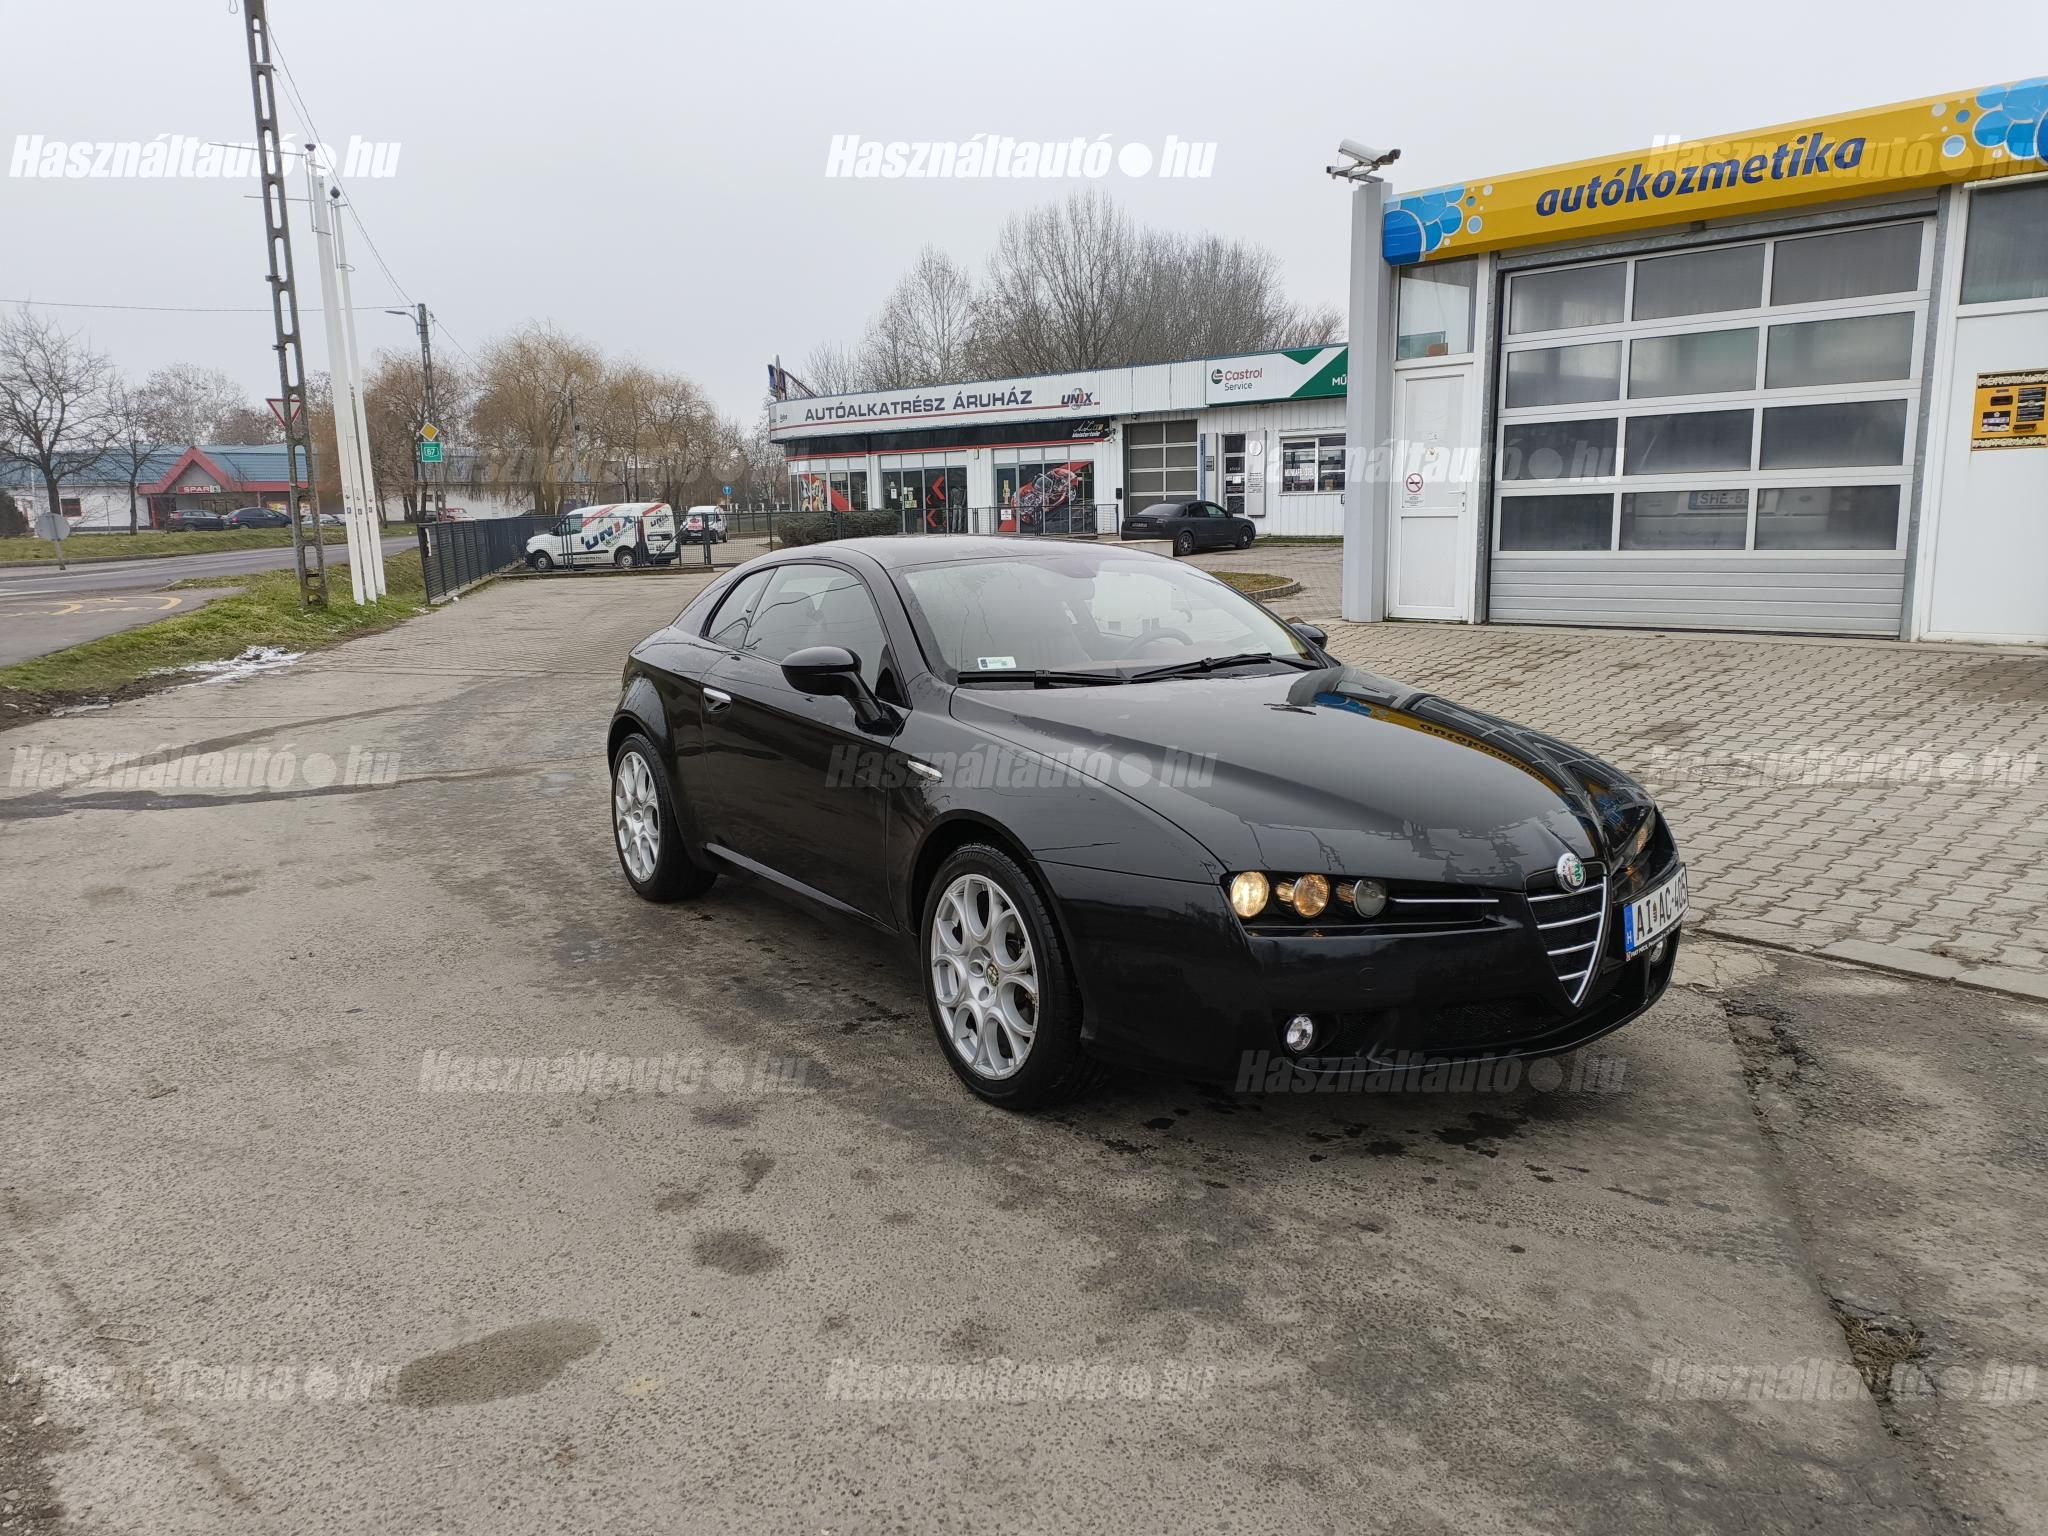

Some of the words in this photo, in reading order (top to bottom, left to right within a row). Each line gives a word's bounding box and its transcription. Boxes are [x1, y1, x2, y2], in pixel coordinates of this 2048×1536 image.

[1536, 131, 1866, 217] autókozmetika
[1225, 368, 1263, 381] Castrol
[1225, 382, 1253, 391] Service
[805, 395, 945, 421] AUTÓALKATRÉSZ
[953, 385, 1033, 410] ÁRUHÁZ
[1061, 391, 1094, 405] UNIX
